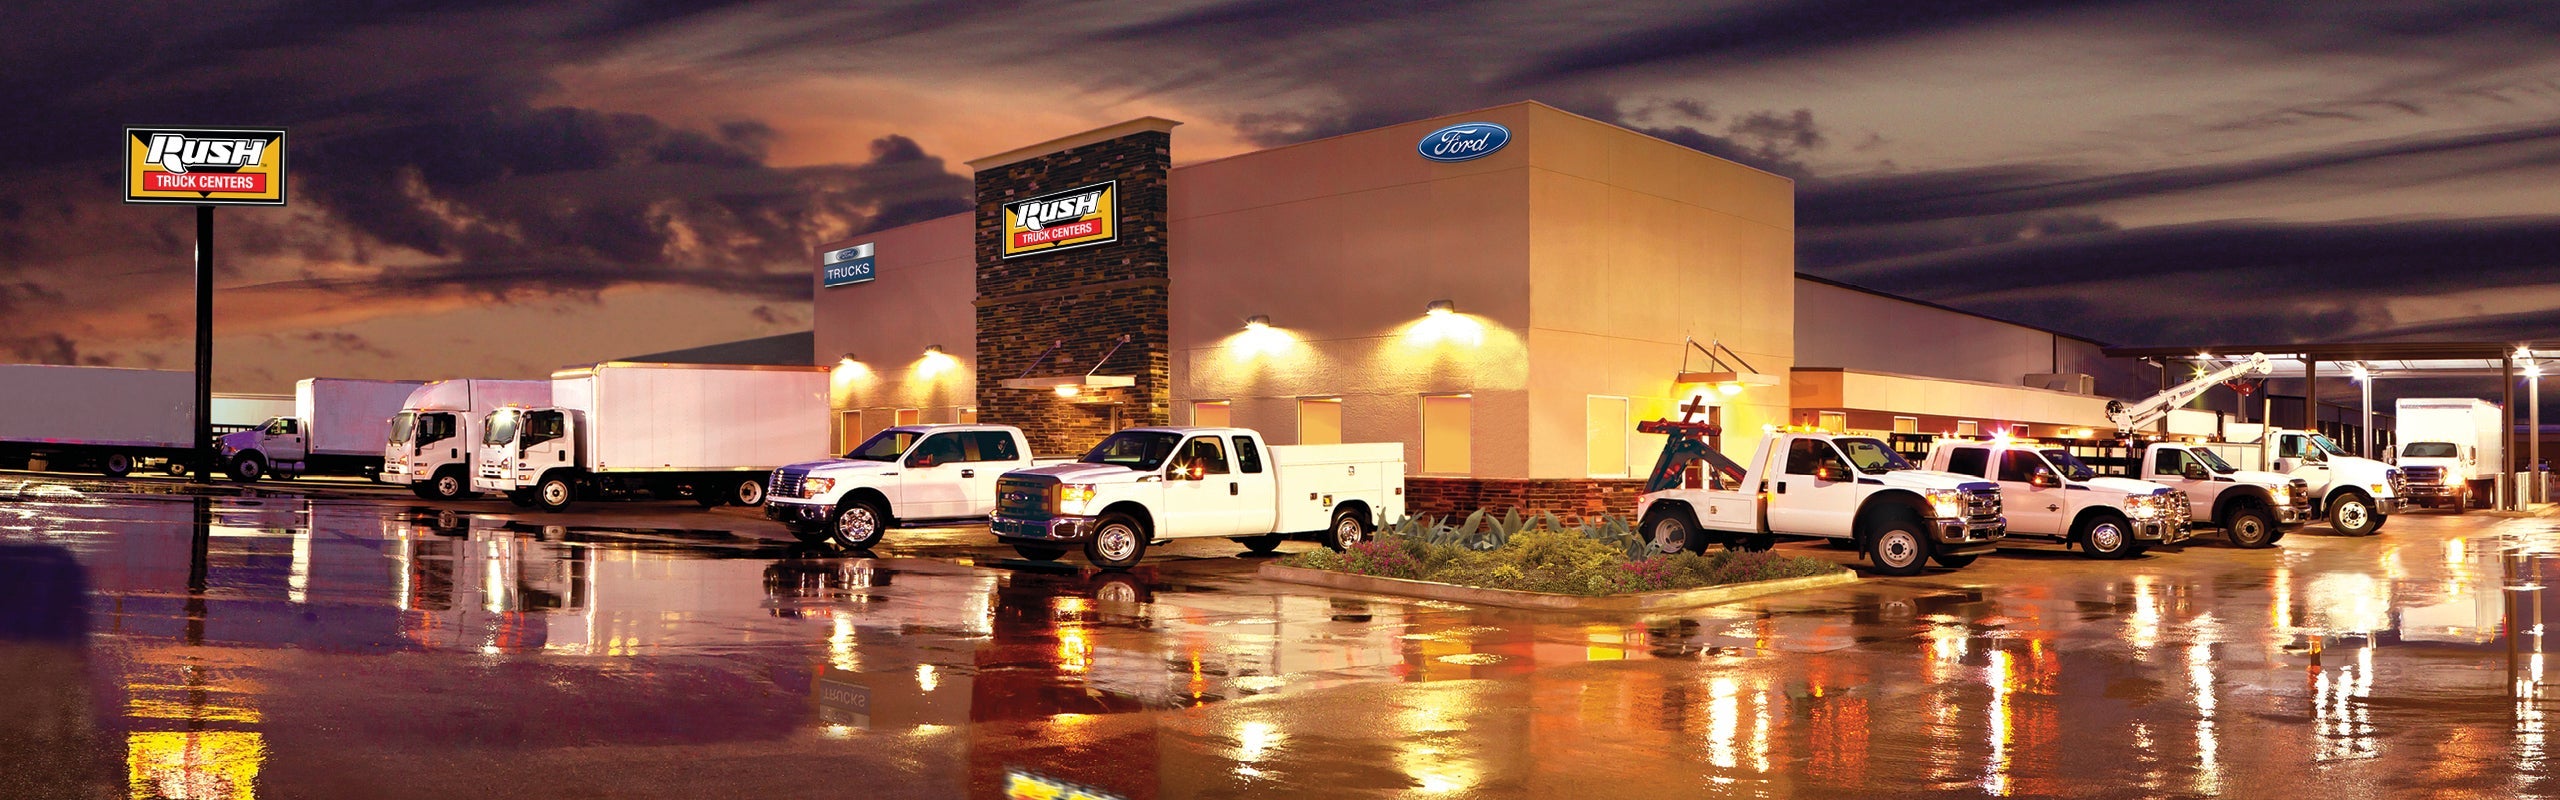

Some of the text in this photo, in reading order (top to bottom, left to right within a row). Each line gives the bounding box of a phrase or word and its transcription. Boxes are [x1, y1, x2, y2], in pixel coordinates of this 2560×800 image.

[145, 134, 266, 174] RUSH
[1434, 128, 1491, 156] Ford
[156, 175, 253, 188] TRUCK CENTERS
[1015, 191, 1101, 231] RUSH
[1022, 223, 1092, 243] TRUCK CENTERS
[828, 263, 870, 279] TRUCKS
